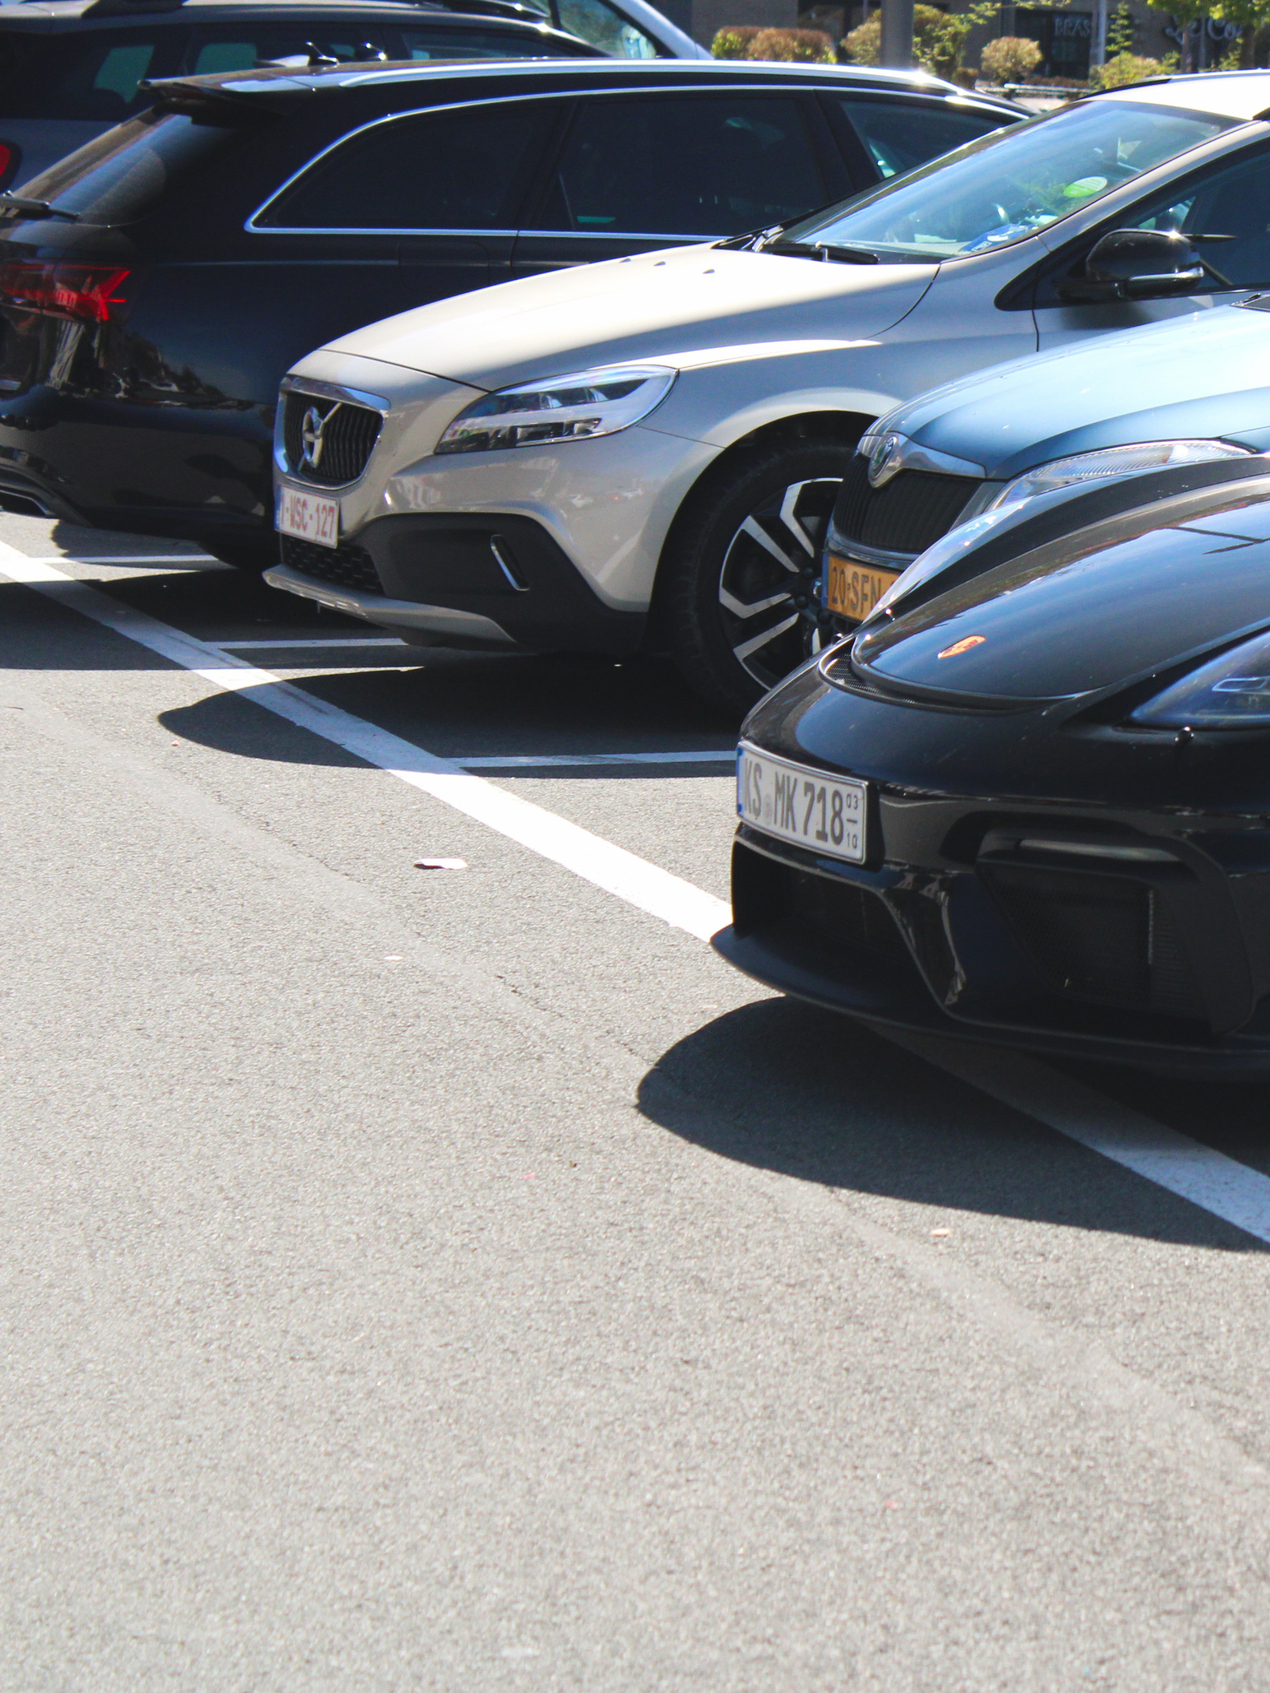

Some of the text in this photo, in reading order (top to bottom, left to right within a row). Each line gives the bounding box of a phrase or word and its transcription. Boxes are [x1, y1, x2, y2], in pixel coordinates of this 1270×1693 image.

[744, 757, 844, 847] KS MK 718
[845, 793, 859, 811] 03
